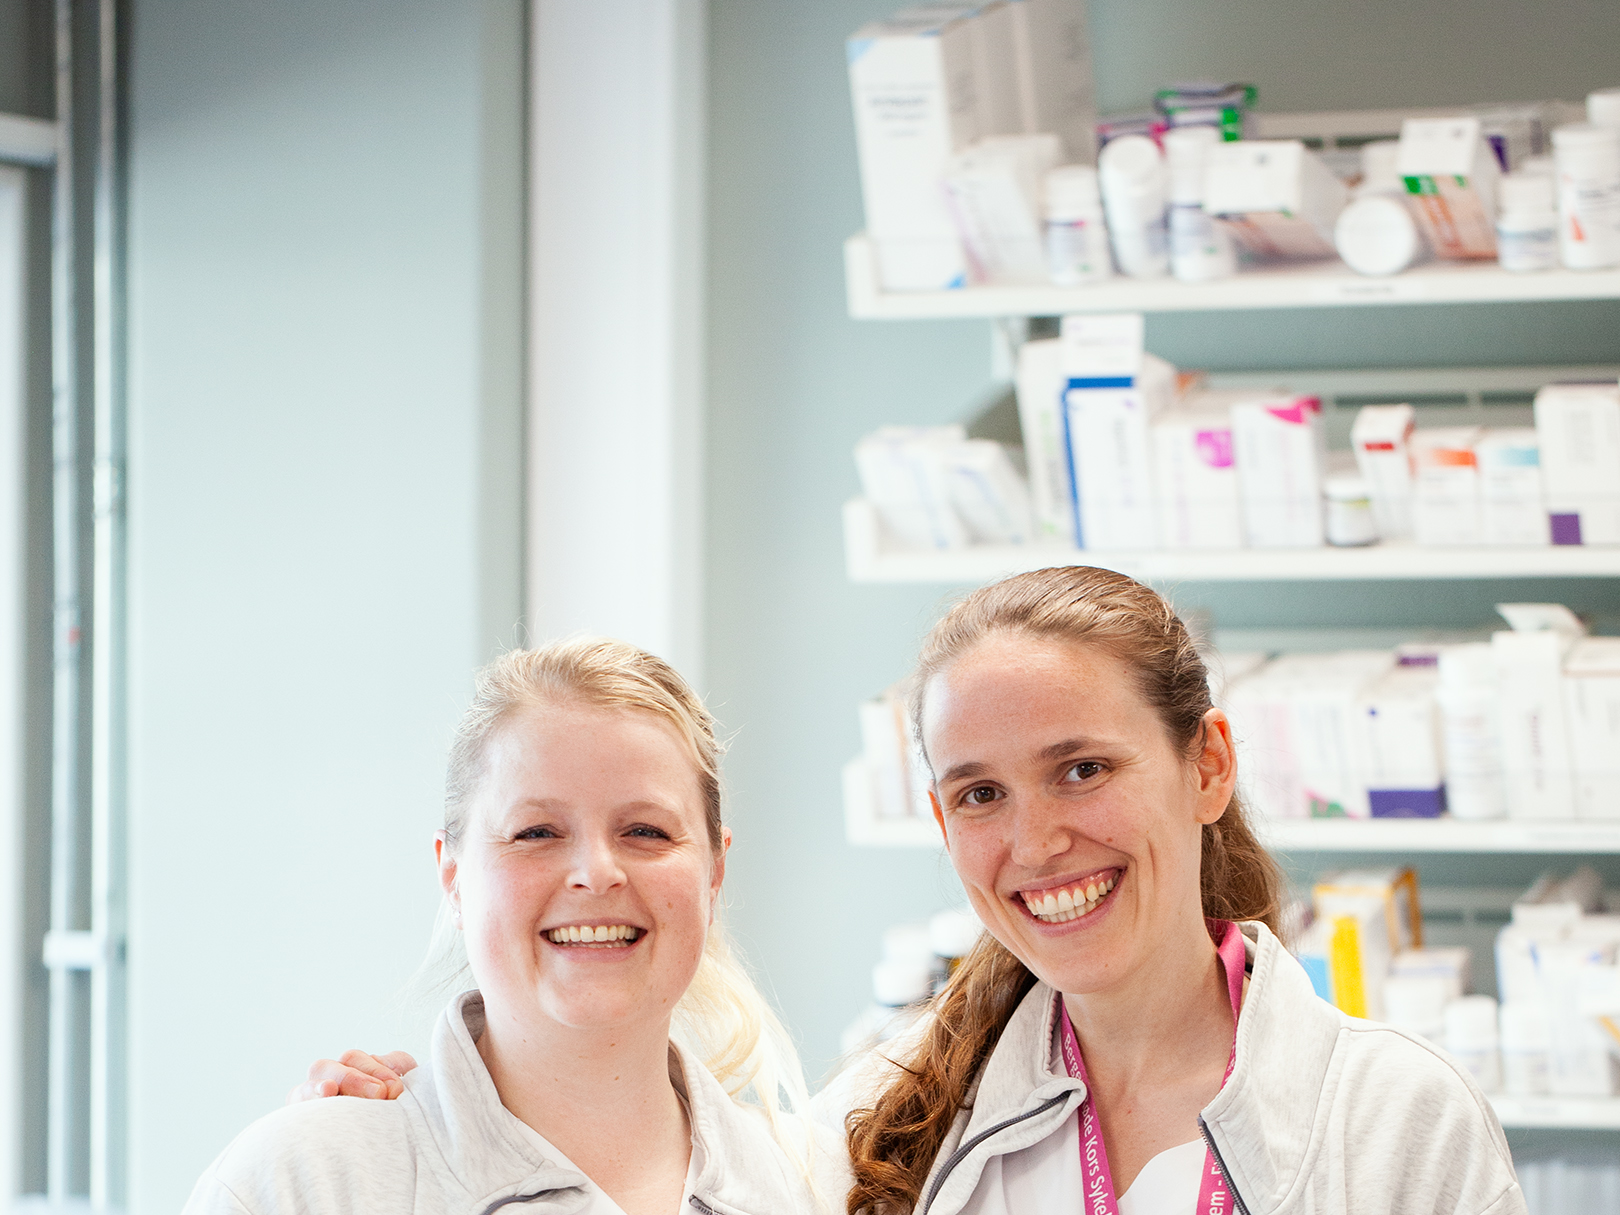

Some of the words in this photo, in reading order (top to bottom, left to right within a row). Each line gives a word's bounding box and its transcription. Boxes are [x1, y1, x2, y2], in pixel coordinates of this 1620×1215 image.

[1064, 1032, 1084, 1080] Berge
[1082, 1094, 1094, 1138] øde
[1085, 1135, 1100, 1176] Kors
